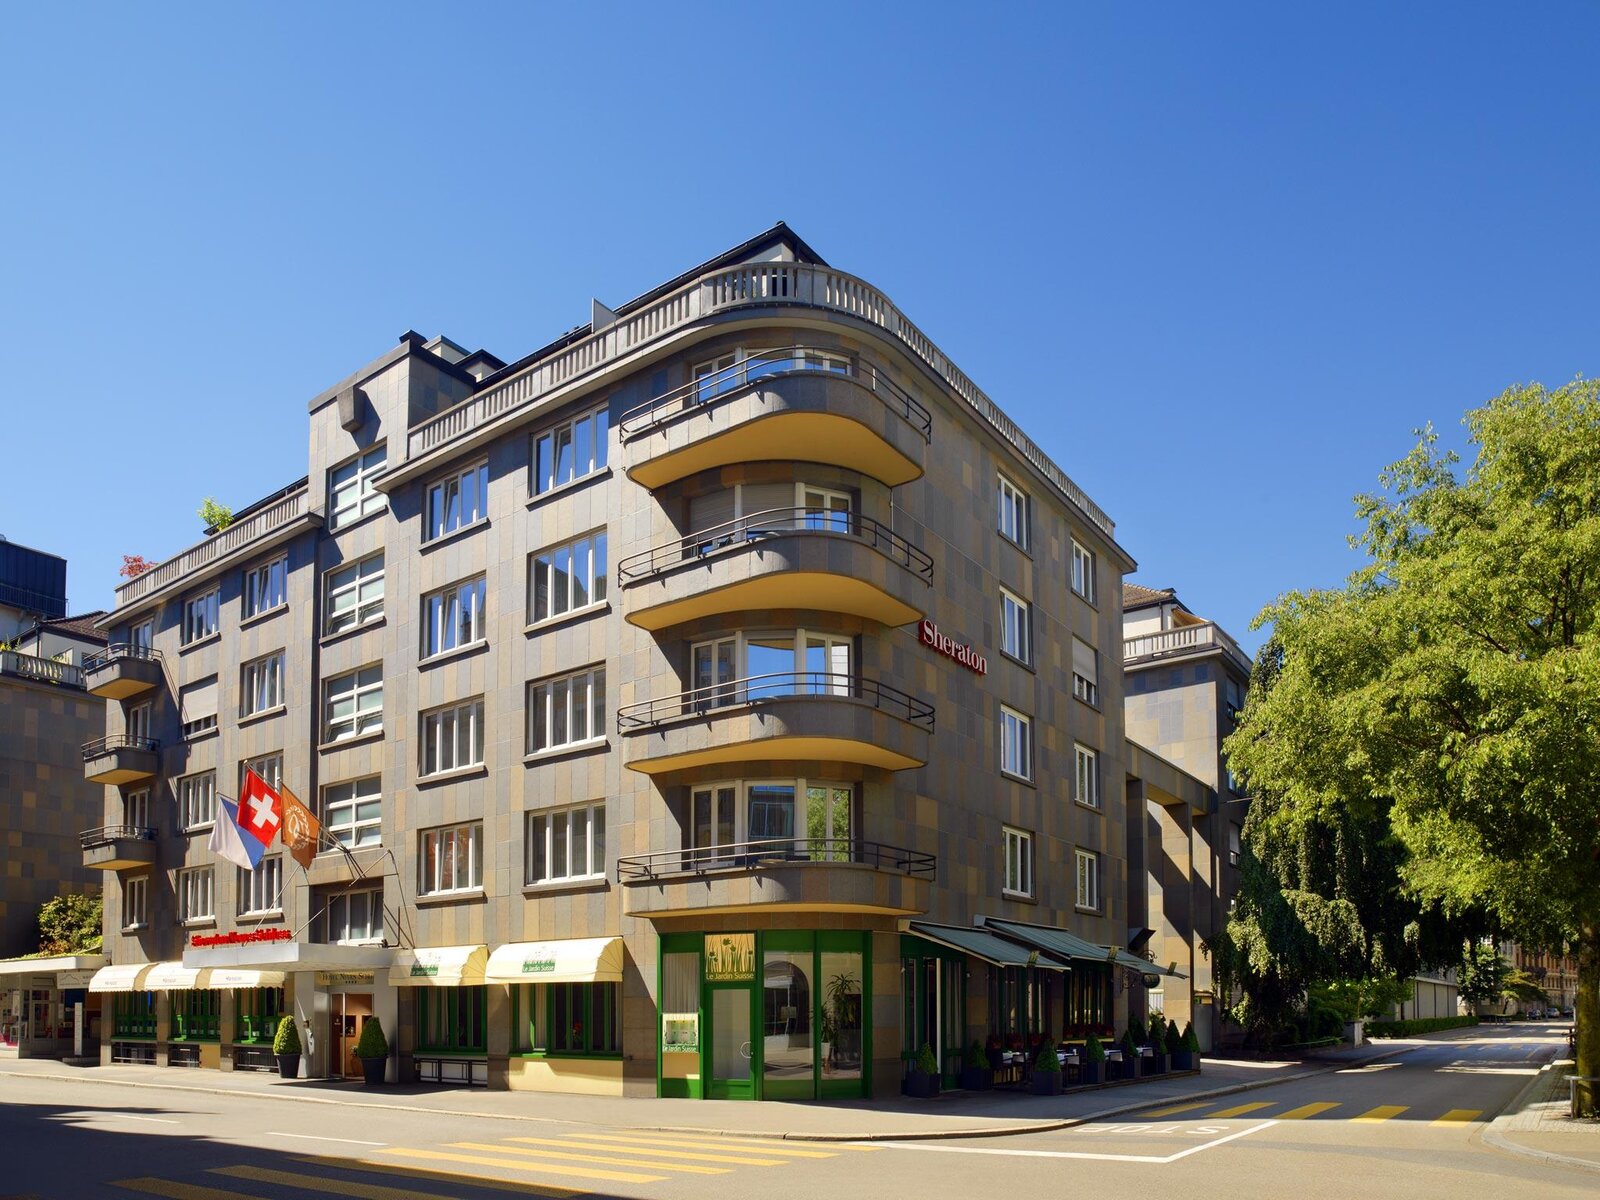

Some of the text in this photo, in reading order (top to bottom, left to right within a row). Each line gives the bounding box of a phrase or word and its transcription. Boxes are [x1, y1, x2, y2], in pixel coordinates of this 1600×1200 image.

[922, 619, 988, 675] Sheraton
[706, 971, 754, 980] Le Jardin Suisse
[1073, 1125, 1230, 1135] STOP
